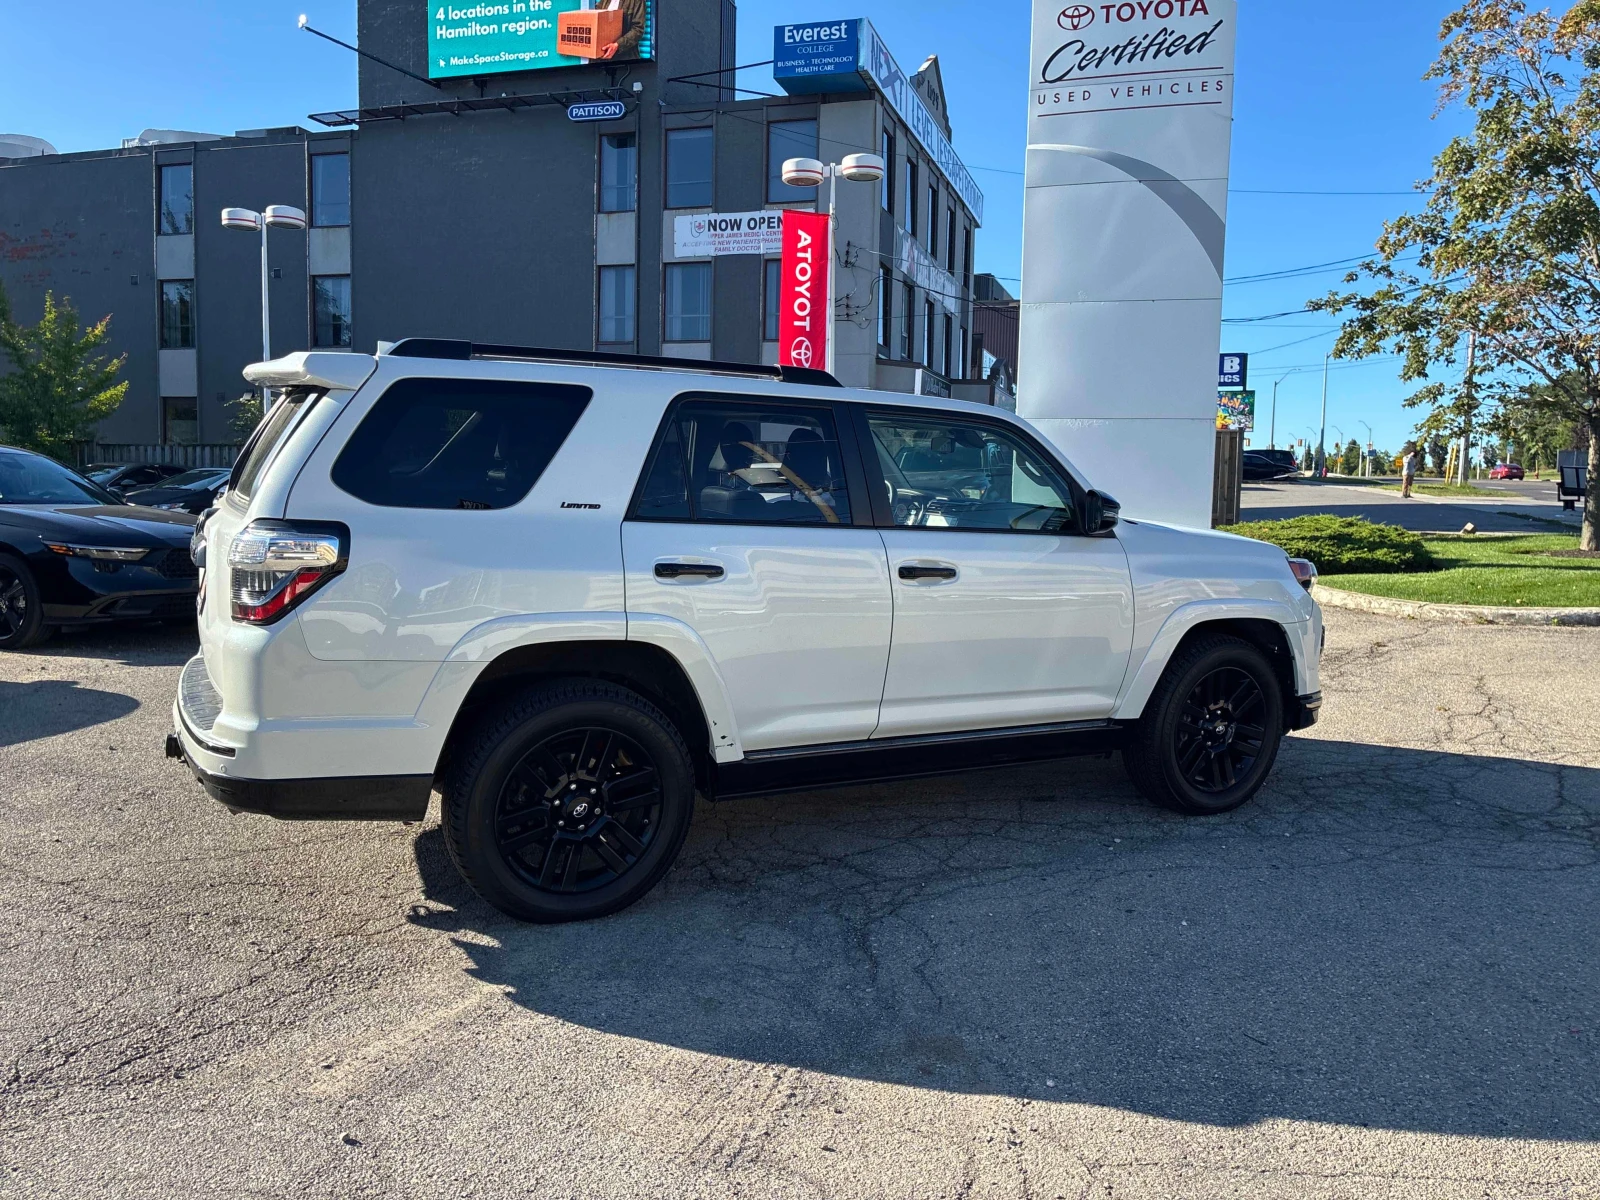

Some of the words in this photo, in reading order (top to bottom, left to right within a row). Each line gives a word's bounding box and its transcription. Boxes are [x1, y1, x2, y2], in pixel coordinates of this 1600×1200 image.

[436, 7, 445, 21] 4
[448, 2, 509, 20] locations
[513, 0, 526, 13] in
[529, 0, 552, 11] the
[1100, 0, 1209, 23] TOYOTA
[437, 21, 498, 39] Hamilton
[502, 16, 552, 35] region.
[567, 27, 591, 35] MAKE
[784, 22, 848, 43] Everest
[450, 50, 549, 66] MakeSpaceStorage.ca
[797, 45, 834, 54] COLLEGE
[1042, 19, 1224, 83] Certified
[778, 60, 805, 68] BUSINESS
[811, 56, 853, 65] TECHNOLOGY
[871, 32, 905, 112] NEXT
[912, 94, 935, 156] LEVEL
[1038, 90, 1091, 105] USED
[1110, 80, 1223, 98] VEHICLES
[572, 106, 620, 117] PATTISON
[707, 217, 742, 232] NOW
